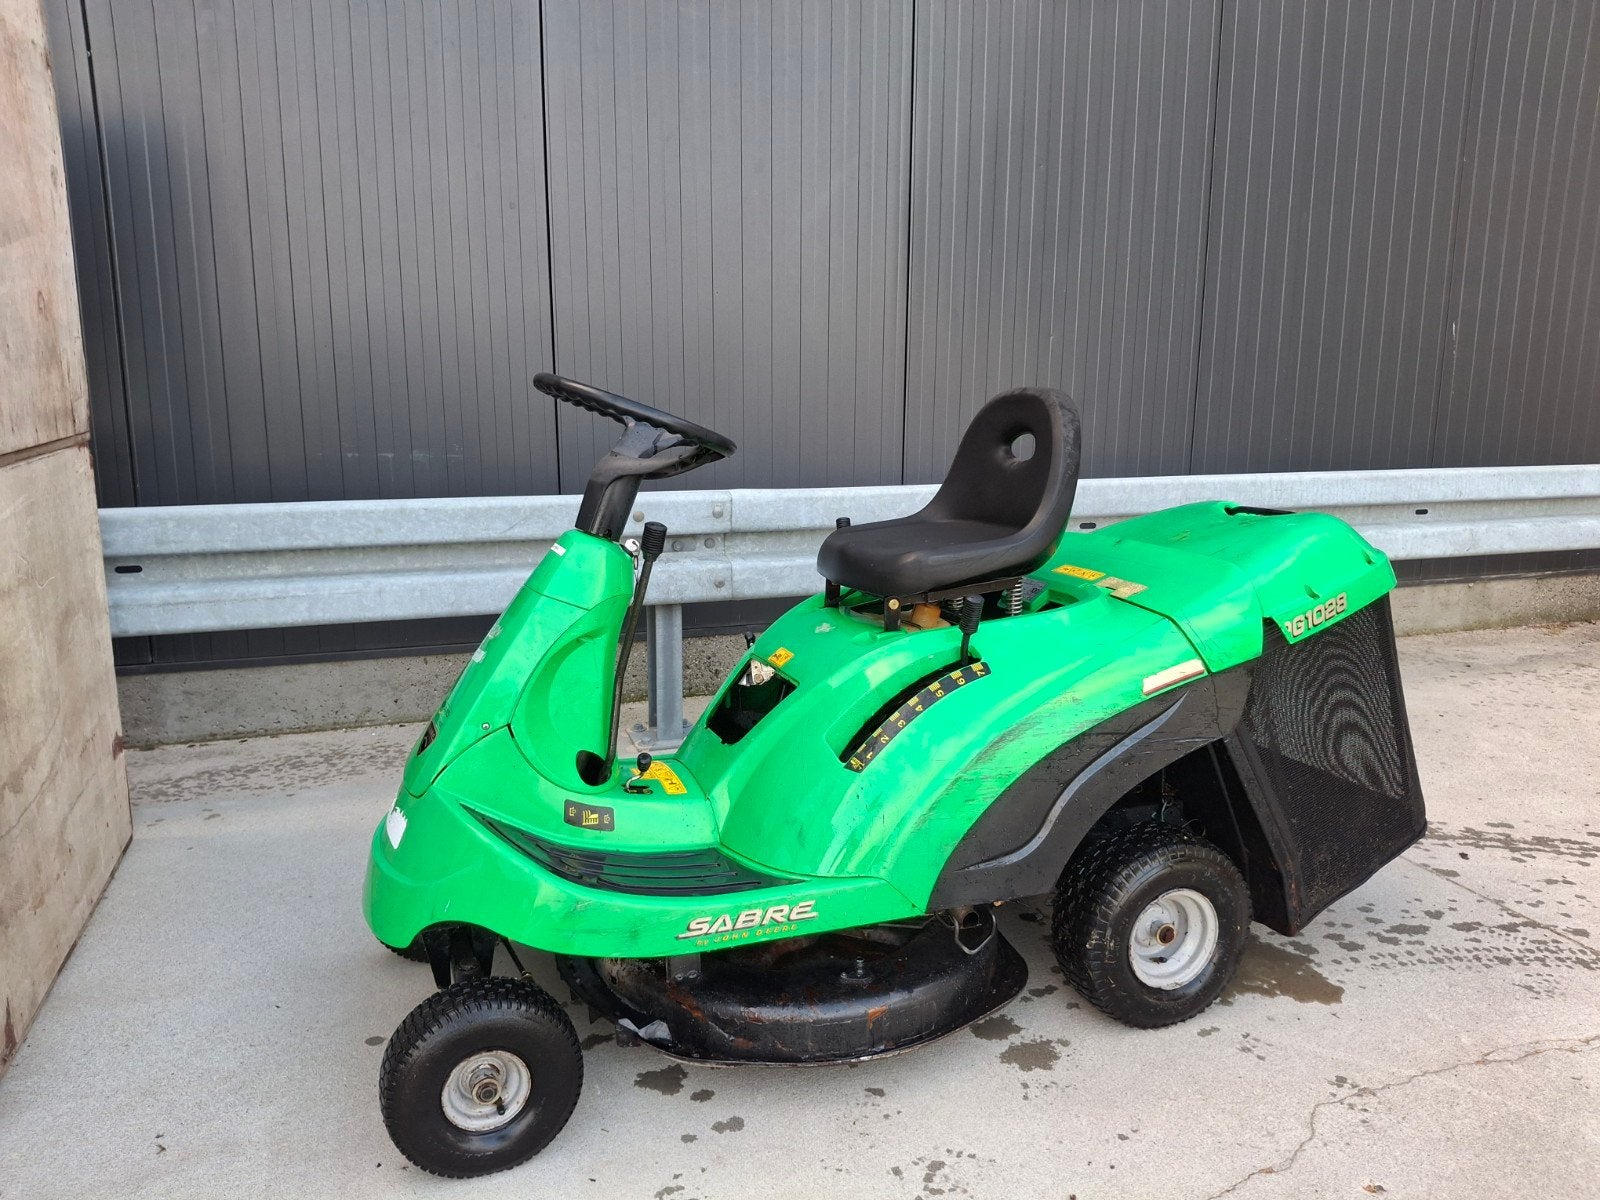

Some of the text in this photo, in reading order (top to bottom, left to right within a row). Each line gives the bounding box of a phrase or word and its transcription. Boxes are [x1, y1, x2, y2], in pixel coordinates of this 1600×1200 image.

[897, 719, 906, 728] 3
[915, 704, 924, 712] 4
[935, 689, 945, 698] 5
[956, 677, 966, 686] 6
[676, 899, 818, 939] SABRE
[714, 931, 749, 943] JOHN
[755, 924, 797, 937] DEERE
